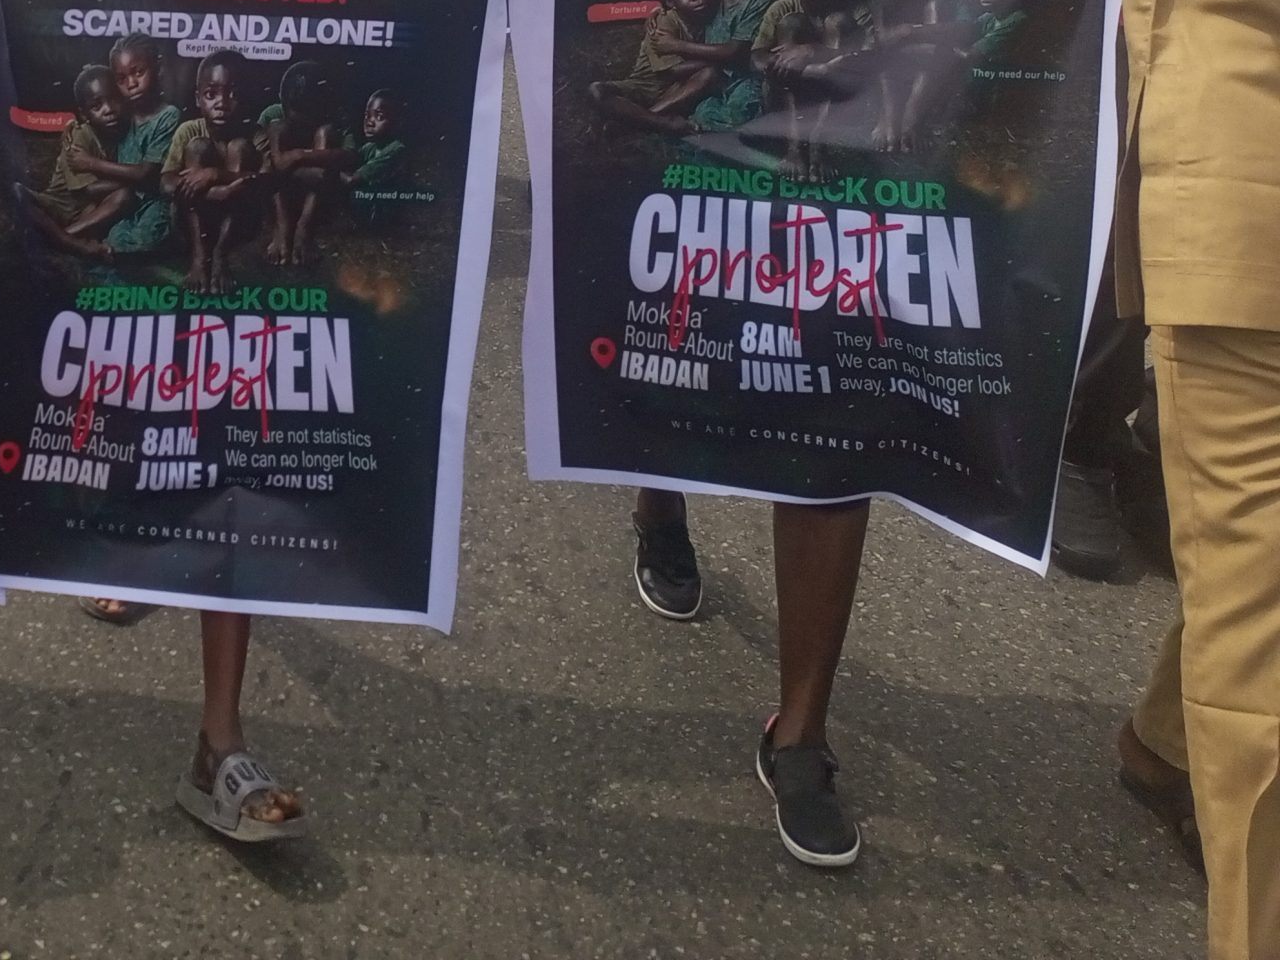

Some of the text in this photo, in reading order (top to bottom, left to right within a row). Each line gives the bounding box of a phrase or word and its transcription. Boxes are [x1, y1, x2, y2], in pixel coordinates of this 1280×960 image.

[610, 5, 647, 15] Tortured
[62, 9, 395, 48] SCARED AND ALONE!
[186, 44, 206, 53] Kept
[252, 46, 285, 56] families
[972, 68, 995, 79] They
[999, 70, 1022, 78] need
[1044, 71, 1066, 81] help
[26, 114, 62, 125] Tortured
[355, 191, 374, 201] They
[376, 191, 396, 199] need
[416, 192, 435, 202] help
[662, 163, 947, 210] #BRING BACK OUR
[628, 192, 981, 329] CHILDREN
[668, 204, 904, 351] protest
[75, 286, 329, 313] #BRING BACK OUR
[740, 320, 803, 358] 8AM
[833, 330, 872, 351] They
[907, 342, 929, 362] not
[934, 347, 1003, 368] statistics
[41, 310, 355, 414] CHILDREN
[620, 350, 709, 391] IBADAN
[739, 359, 832, 393] JUNE 1
[836, 353, 863, 368] We
[867, 356, 898, 371] can
[923, 367, 973, 397] longer
[978, 374, 1012, 395] look
[73, 313, 292, 449] protest
[889, 377, 927, 404] JOIN
[931, 391, 960, 418] US!
[141, 427, 199, 456] 8AM
[225, 425, 258, 447] They
[288, 428, 309, 444] not
[313, 427, 372, 448] statistics
[671, 420, 692, 431] WE
[705, 424, 736, 437] ARE
[749, 428, 864, 451] CONCERNED
[22, 453, 111, 491] IBADAN
[136, 460, 218, 491] JUNE 1
[225, 449, 377, 472] We can no longer look
[265, 474, 302, 488] JOIN
[306, 474, 334, 491] US!
[66, 519, 86, 530] WE
[138, 526, 239, 544] CONCERNED
[251, 534, 338, 551] CITIZENS!
